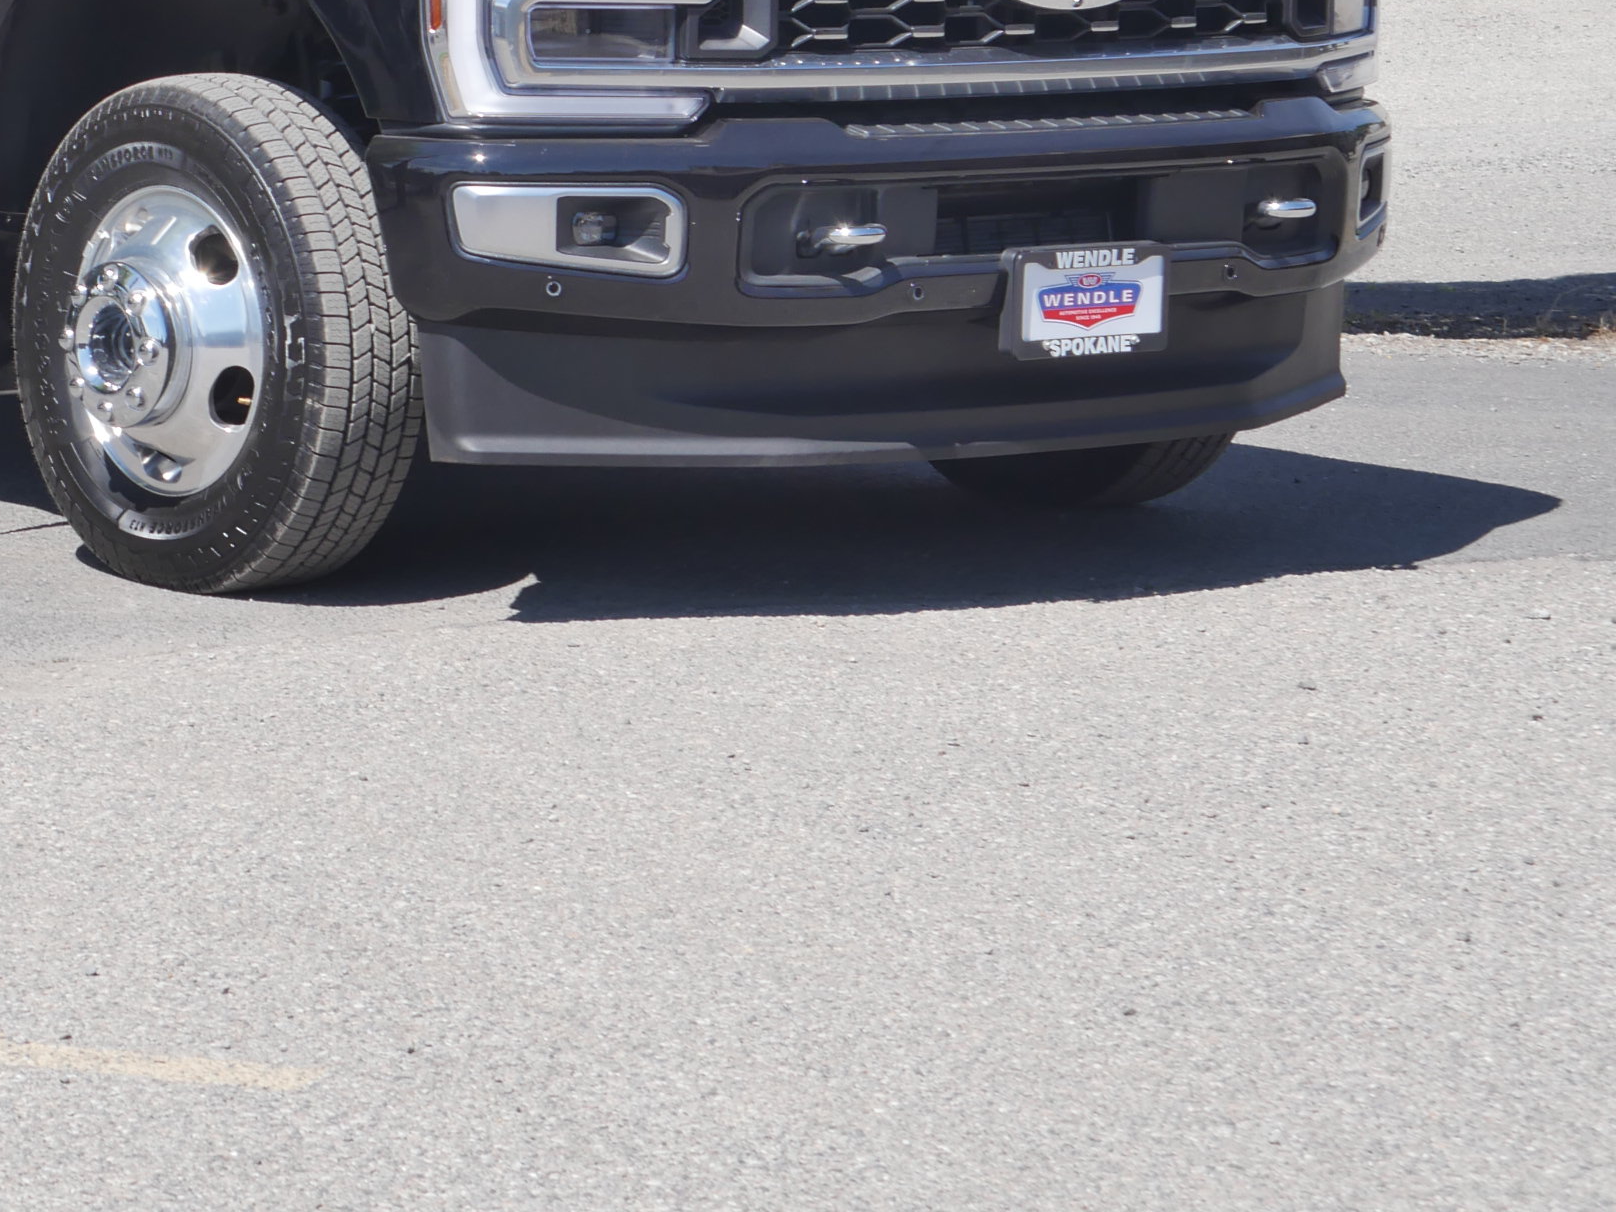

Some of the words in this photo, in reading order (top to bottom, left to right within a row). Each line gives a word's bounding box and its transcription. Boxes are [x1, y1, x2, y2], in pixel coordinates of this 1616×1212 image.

[1056, 248, 1136, 269] WENDLE
[1043, 289, 1134, 307] WENDLE
[1049, 335, 1133, 358] SPOKANE
